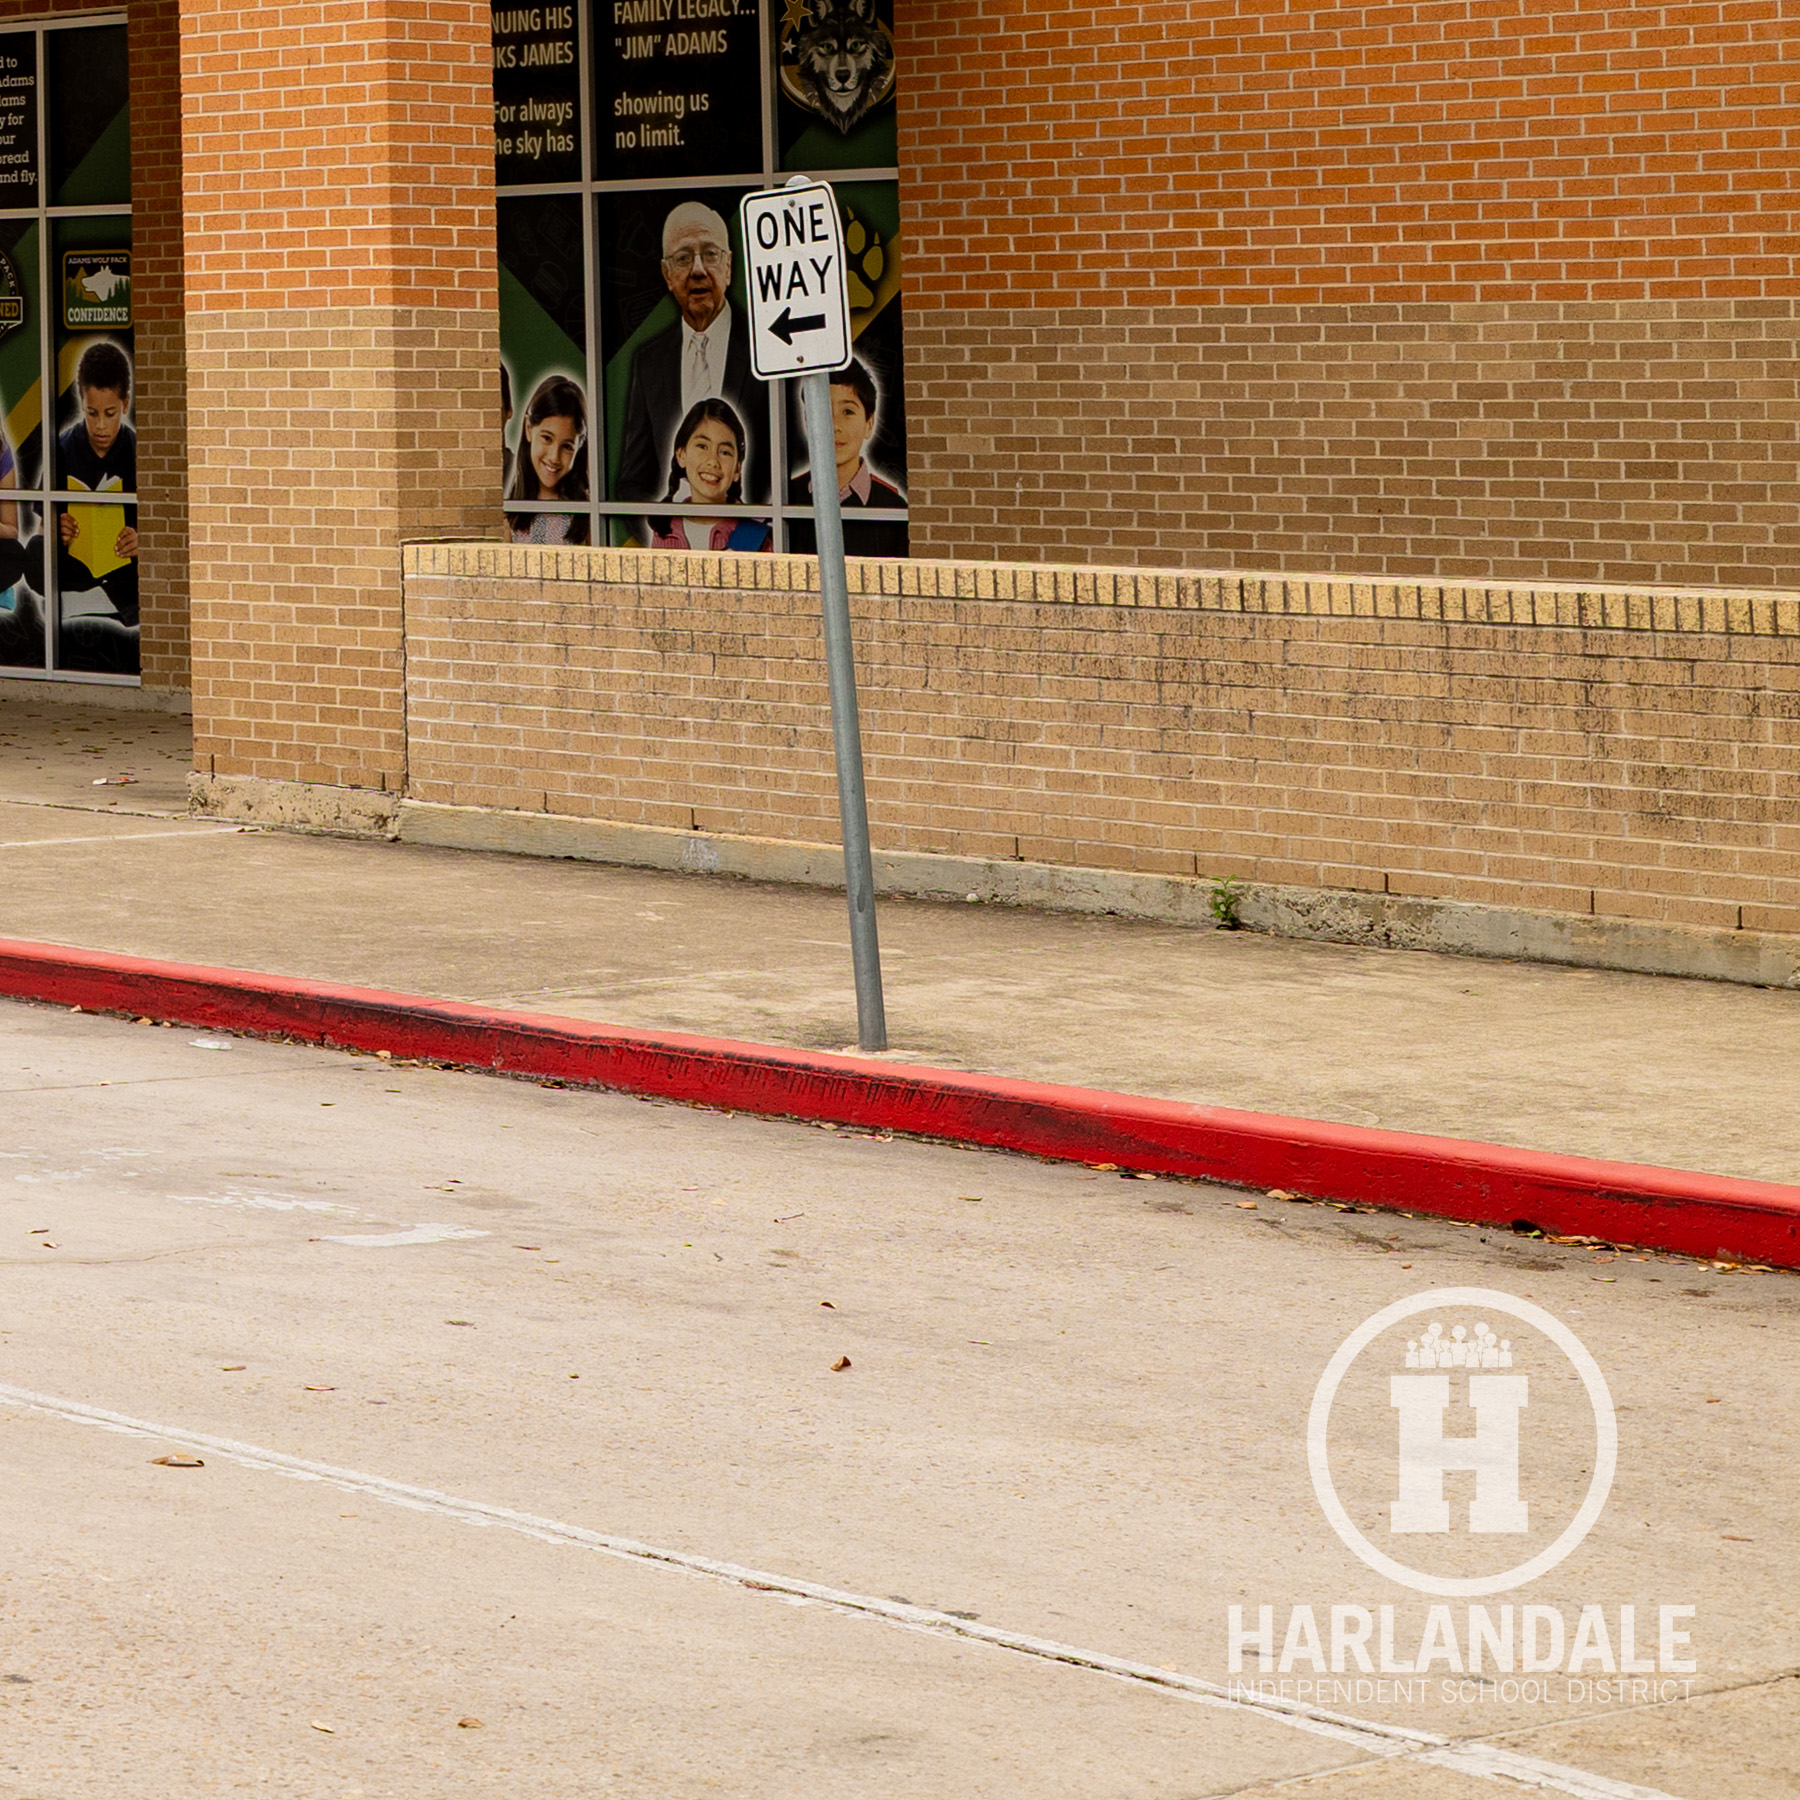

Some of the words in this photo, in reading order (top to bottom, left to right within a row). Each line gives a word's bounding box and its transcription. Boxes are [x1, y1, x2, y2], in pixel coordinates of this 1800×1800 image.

[545, 5, 573, 30] HIS
[6, 57, 18, 68] to
[519, 41, 574, 67] JAMES
[665, 29, 728, 56] ADAMS
[7, 112, 25, 126] for
[494, 101, 516, 123] For
[519, 98, 573, 127] always
[614, 90, 685, 119] showing
[690, 92, 709, 112] us
[516, 130, 542, 160] sky
[546, 129, 574, 153] has
[615, 129, 637, 149] no
[640, 122, 685, 148] limit.
[20, 169, 38, 186] fly.
[756, 203, 829, 250] ONE
[0, 258, 16, 288] PACK
[756, 255, 833, 303] WAY
[68, 307, 129, 322] CONFIDENCE
